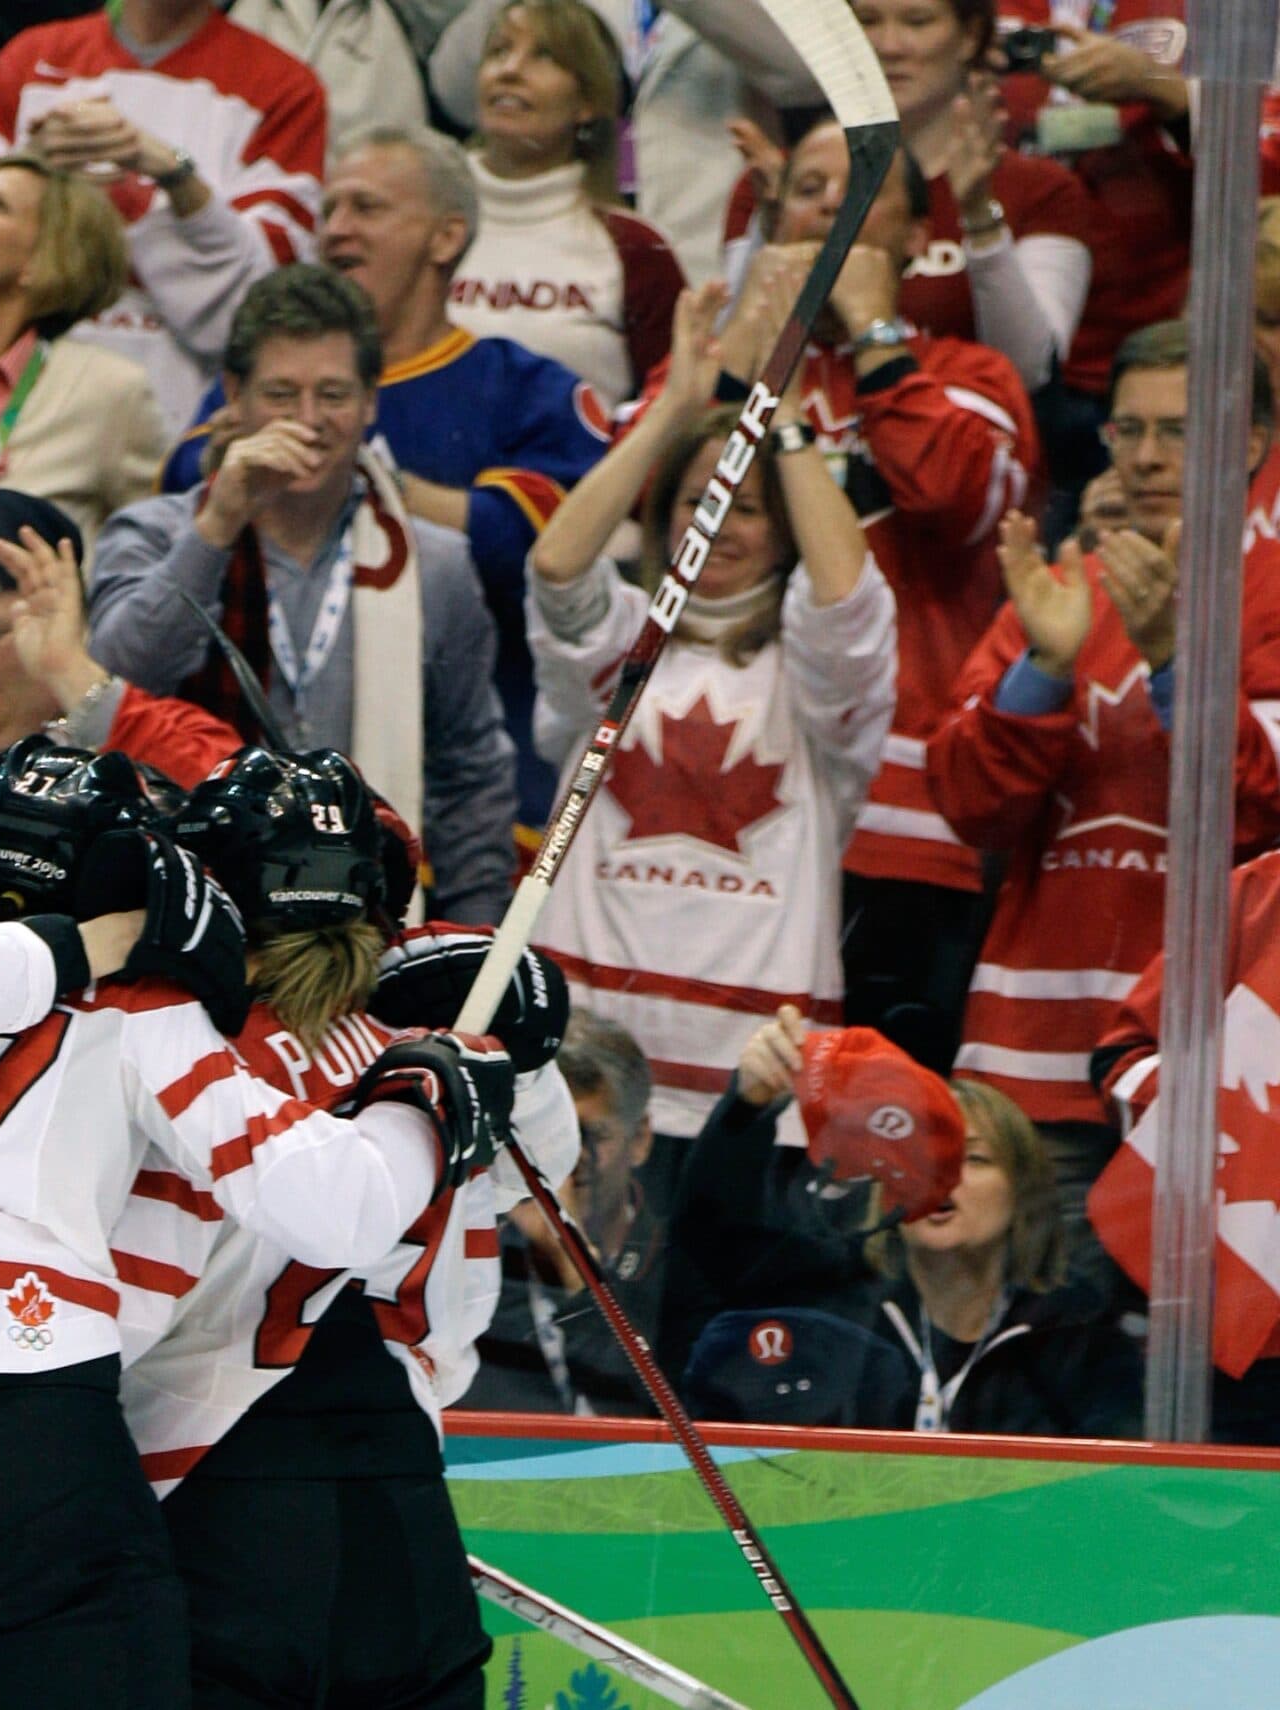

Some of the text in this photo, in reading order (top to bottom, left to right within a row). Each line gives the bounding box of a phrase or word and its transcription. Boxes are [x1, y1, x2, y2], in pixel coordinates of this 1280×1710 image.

[648, 381, 780, 634] BAUER
[12, 770, 57, 796] 27
[31, 858, 67, 880] 2010
[595, 861, 777, 897] CANADA
